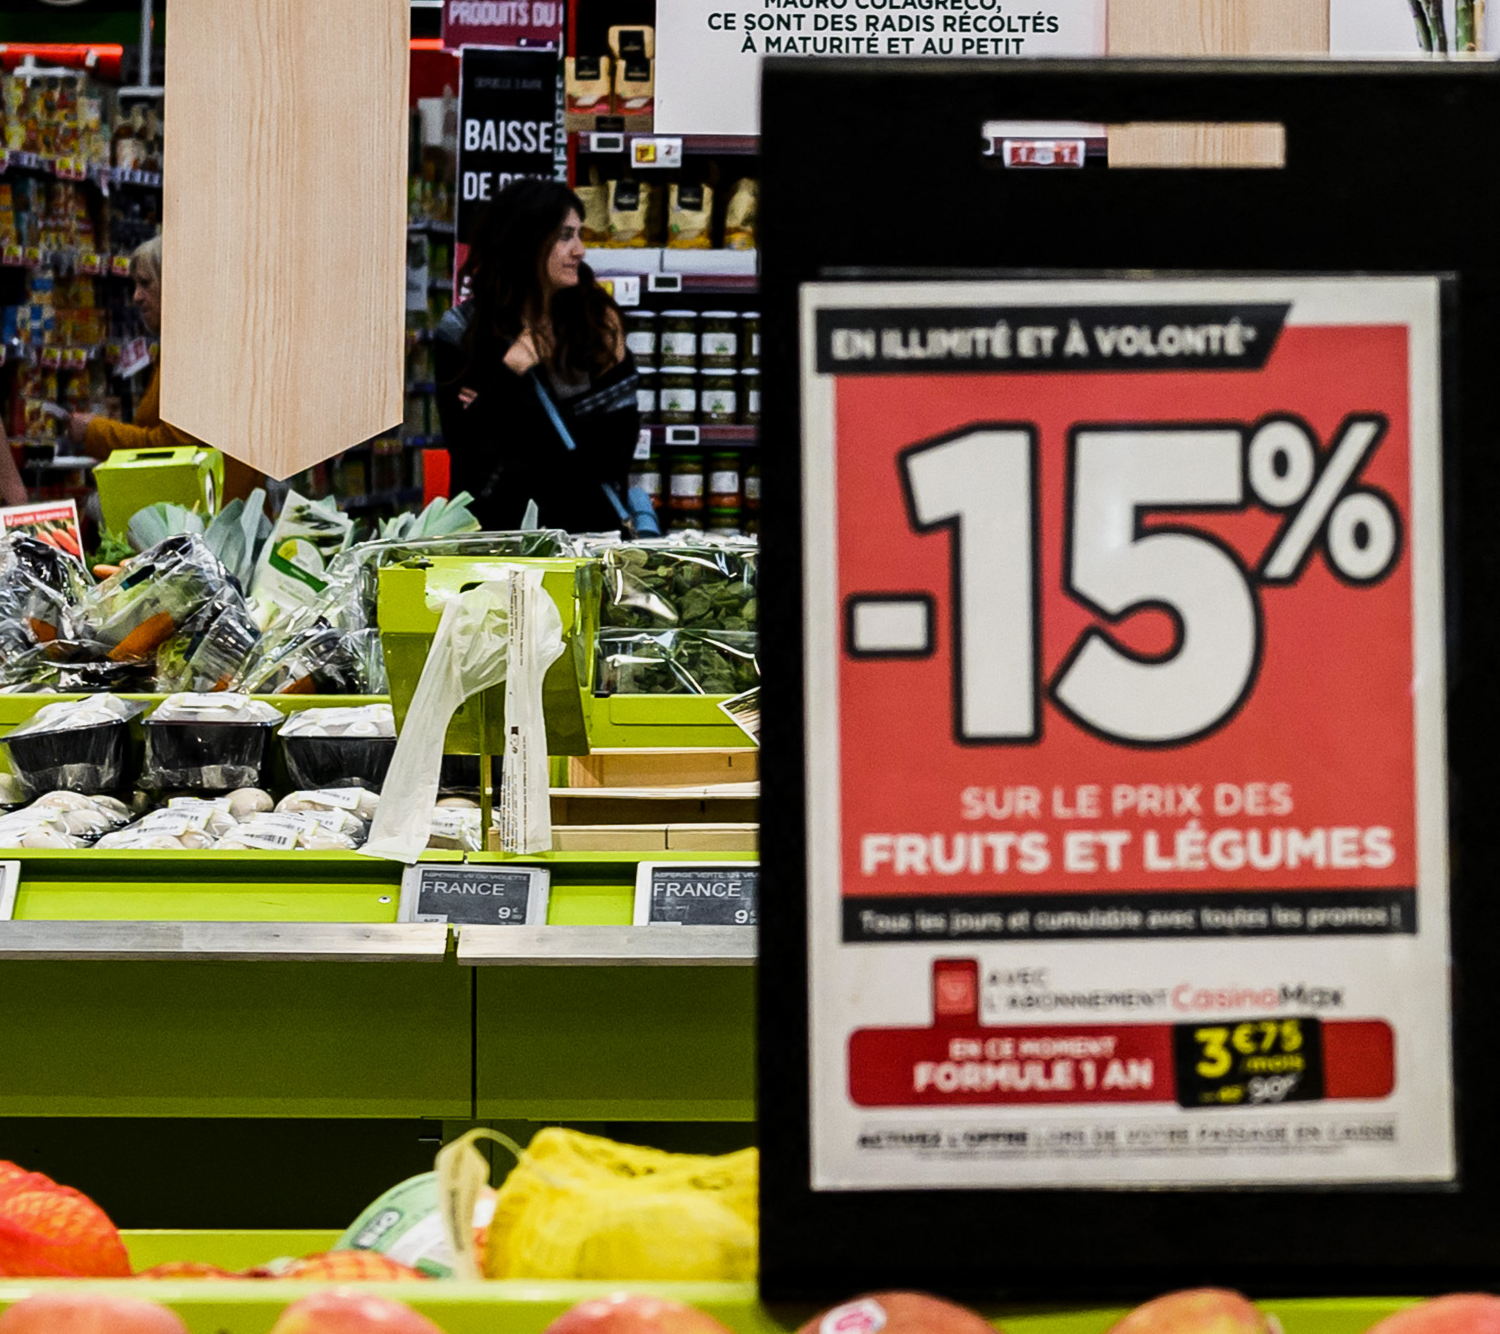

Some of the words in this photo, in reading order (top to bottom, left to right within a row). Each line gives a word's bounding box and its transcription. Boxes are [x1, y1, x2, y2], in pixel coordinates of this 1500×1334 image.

[708, 13, 736, 30] CE
[744, 13, 806, 31] SONT
[814, 14, 857, 31] DES
[866, 15, 934, 32] RADIS
[944, 11, 1058, 33] RÉCOLTÉS
[741, 33, 756, 53] À
[766, 33, 878, 54] MATURITÉ
[888, 38, 914, 54] ET
[922, 38, 953, 54] AU
[962, 38, 1024, 55] PETIT
[847, 413, 1404, 749] -15%
[862, 833, 1050, 875] FRUITS
[1059, 831, 1131, 872] ET
[1144, 822, 1395, 871] LÉGUMES
[421, 881, 505, 896] FRANCE
[653, 882, 741, 897] FRANCE
